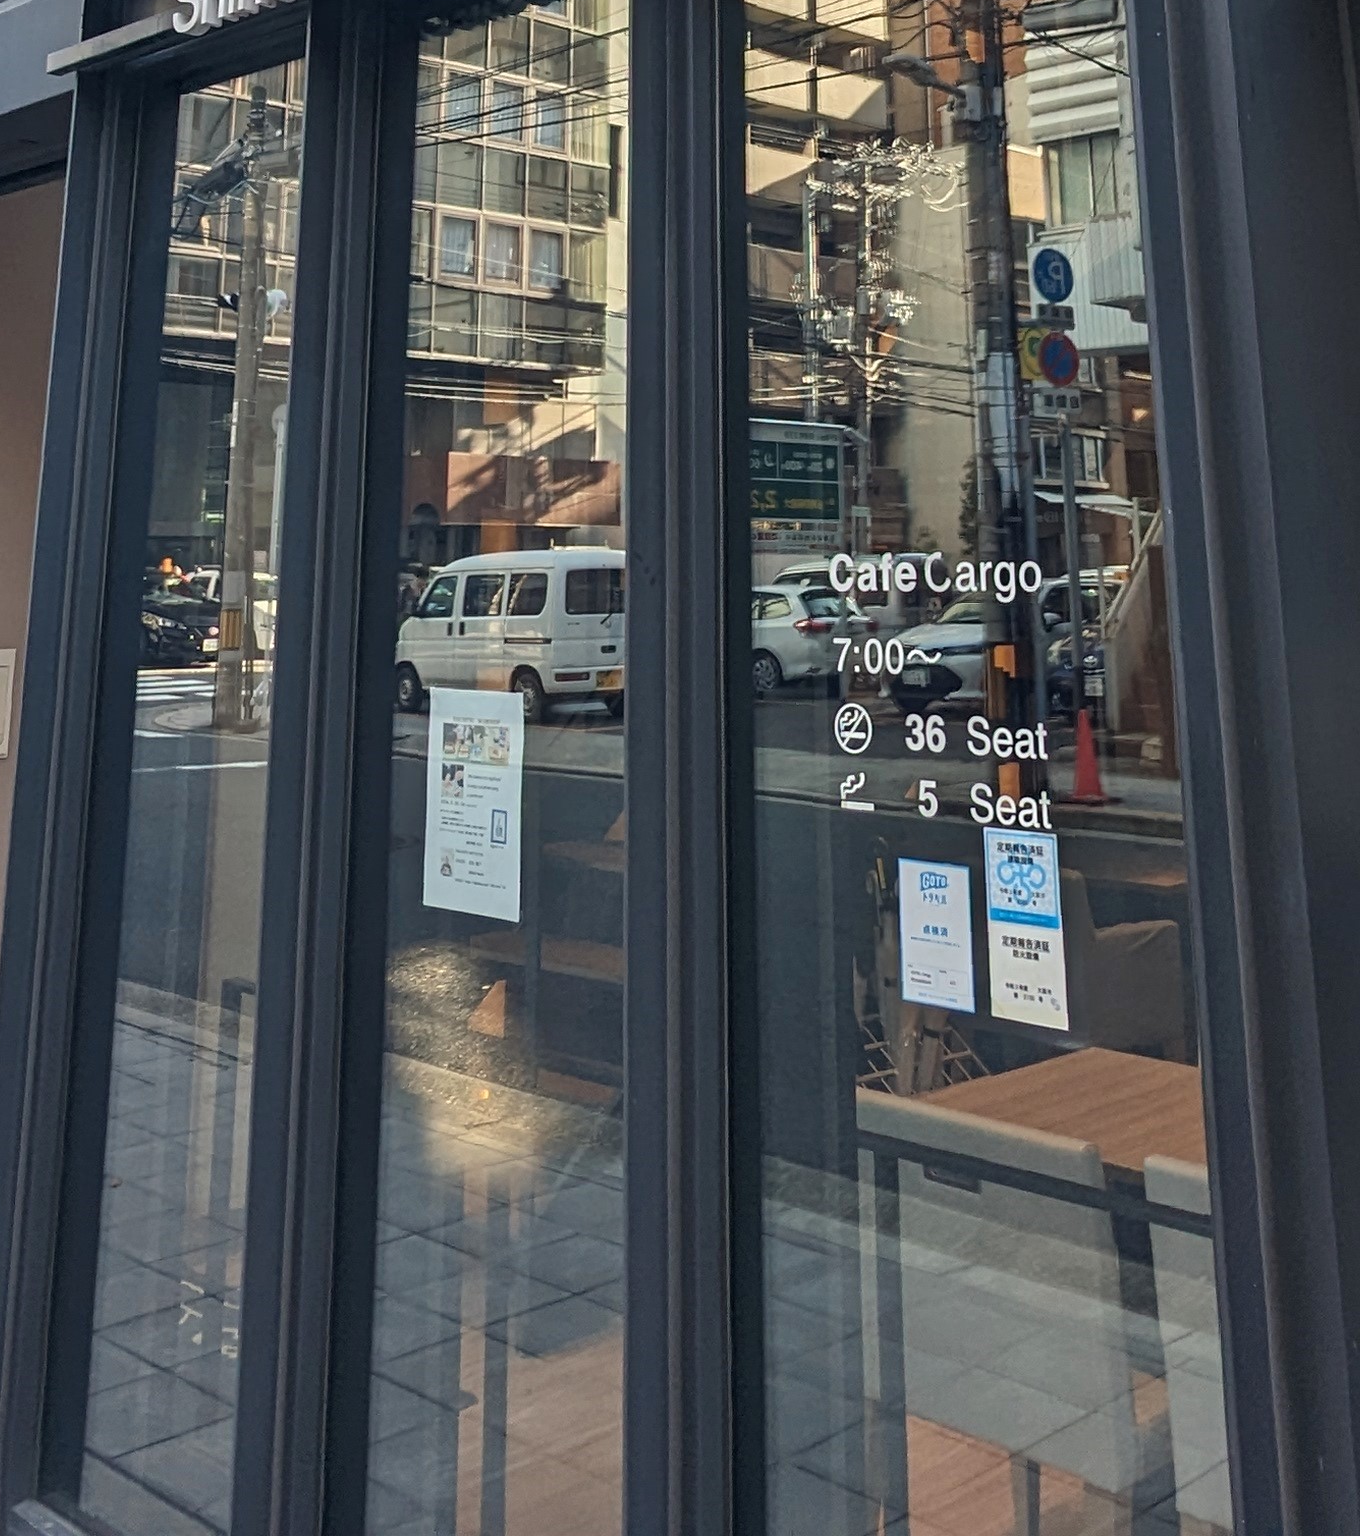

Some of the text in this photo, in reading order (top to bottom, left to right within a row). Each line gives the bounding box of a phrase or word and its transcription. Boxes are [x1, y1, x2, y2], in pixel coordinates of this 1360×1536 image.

[828, 552, 1042, 603] Cafe Cargo
[904, 713, 1048, 760] 36 Seat
[918, 779, 1053, 829] 5 Seat
